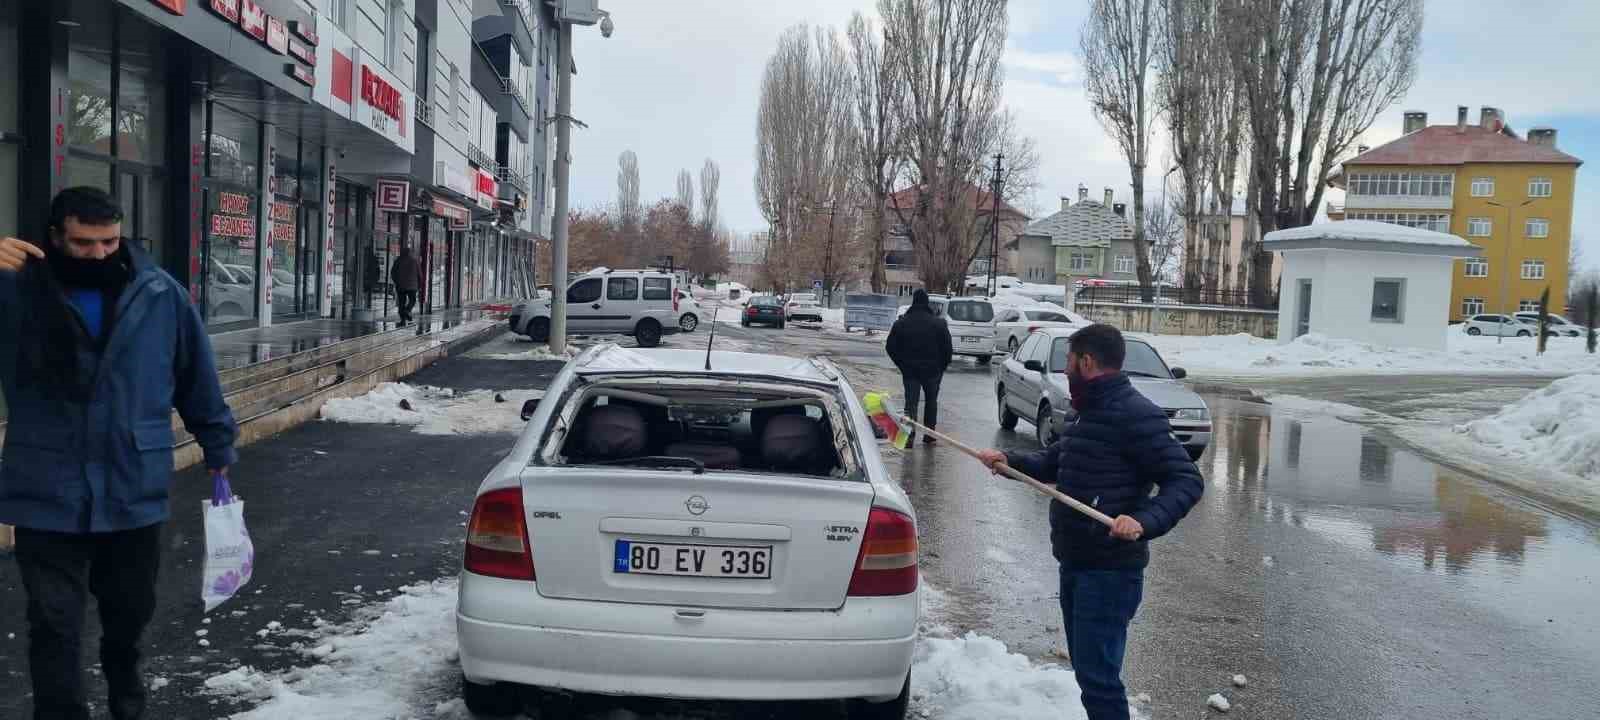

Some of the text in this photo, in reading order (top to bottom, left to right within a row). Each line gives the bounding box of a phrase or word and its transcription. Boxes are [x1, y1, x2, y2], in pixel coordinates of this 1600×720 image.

[361, 64, 402, 120] ECZANE
[371, 107, 390, 133] HAYAT
[384, 187, 399, 204] E
[265, 147, 275, 304] ECZANE
[326, 166, 336, 299] ECZANE
[533, 511, 561, 520] OPEL
[824, 525, 859, 534] ASTRA
[630, 546, 659, 571] 80
[675, 549, 706, 573] EV
[720, 550, 767, 574] 336
